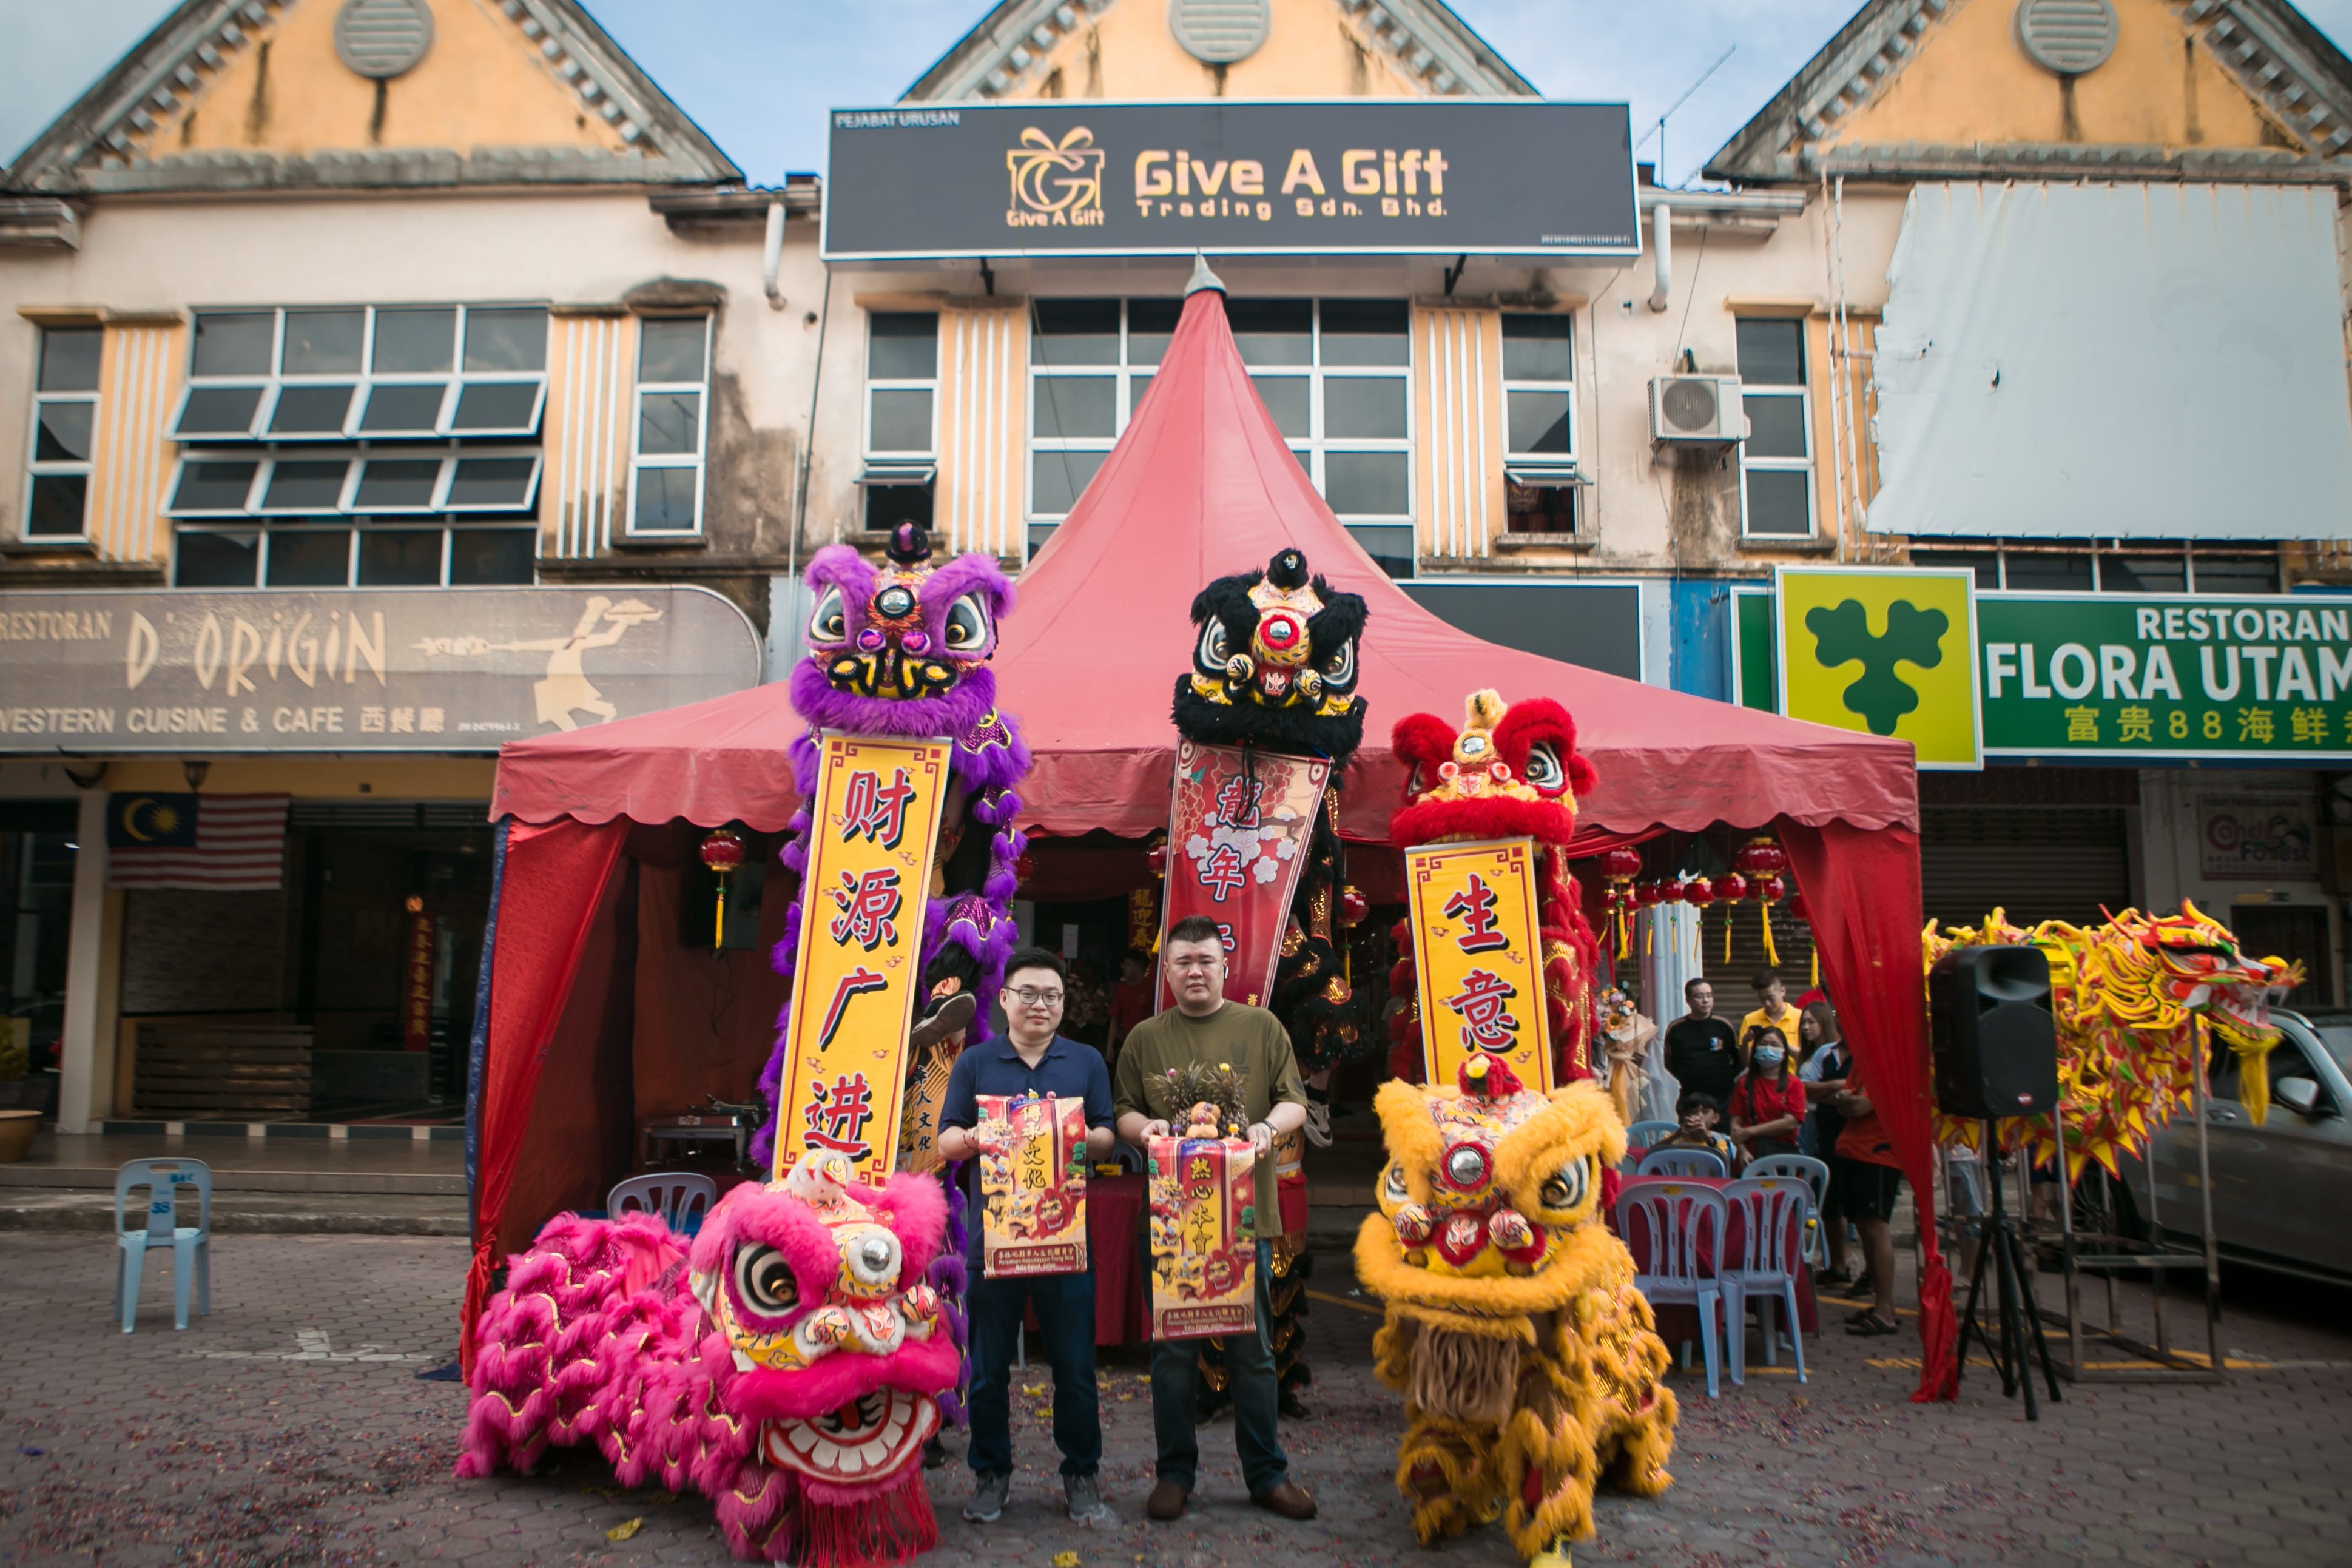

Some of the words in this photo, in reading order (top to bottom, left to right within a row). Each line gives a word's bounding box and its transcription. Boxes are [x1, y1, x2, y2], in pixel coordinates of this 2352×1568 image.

[834, 112, 897, 128] PEJABAT
[898, 110, 960, 127] URUSAN
[1135, 149, 1265, 198] Give
[1281, 149, 1326, 195] A
[1341, 149, 1449, 195] Gift
[1006, 211, 1049, 227] Give
[1052, 211, 1067, 226] A
[1071, 210, 1105, 226] Gift
[1136, 198, 1272, 221] Trading
[1295, 198, 1363, 217] Sdn.
[1381, 198, 1448, 217] Bhd.
[0, 611, 113, 641] RESTORAN
[2135, 608, 2350, 641] RESTORAN
[1985, 642, 2183, 701] FLORA
[126, 708, 227, 733] CUISINE
[240, 708, 260, 733] &
[272, 707, 344, 733] CAFE
[803, 768, 917, 1157] 财源广进
[1443, 873, 1521, 1053] 生意
